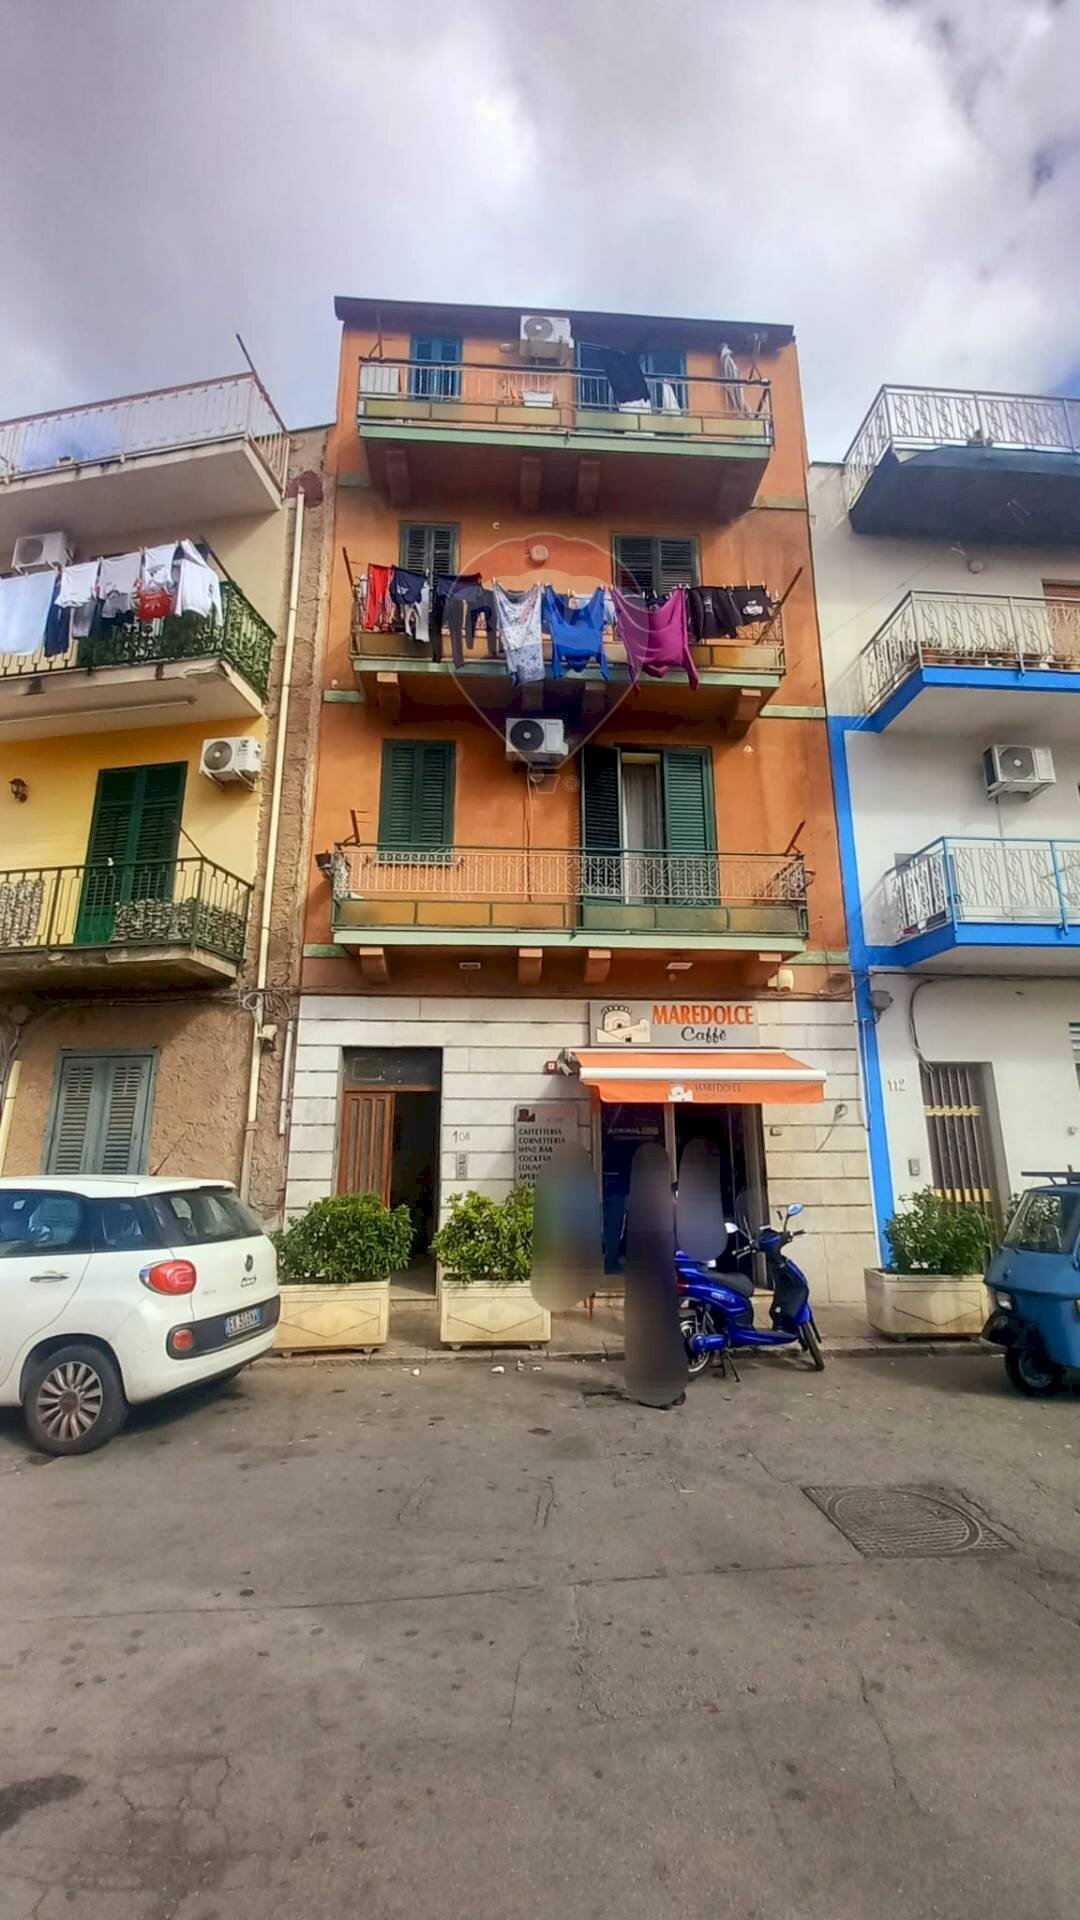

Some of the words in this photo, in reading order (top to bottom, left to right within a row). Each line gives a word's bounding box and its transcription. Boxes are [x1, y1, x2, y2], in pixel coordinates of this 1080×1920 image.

[652, 1004, 753, 1025] MAREDOLCE
[887, 1078, 905, 1091] 112
[452, 1130, 470, 1143] 108
